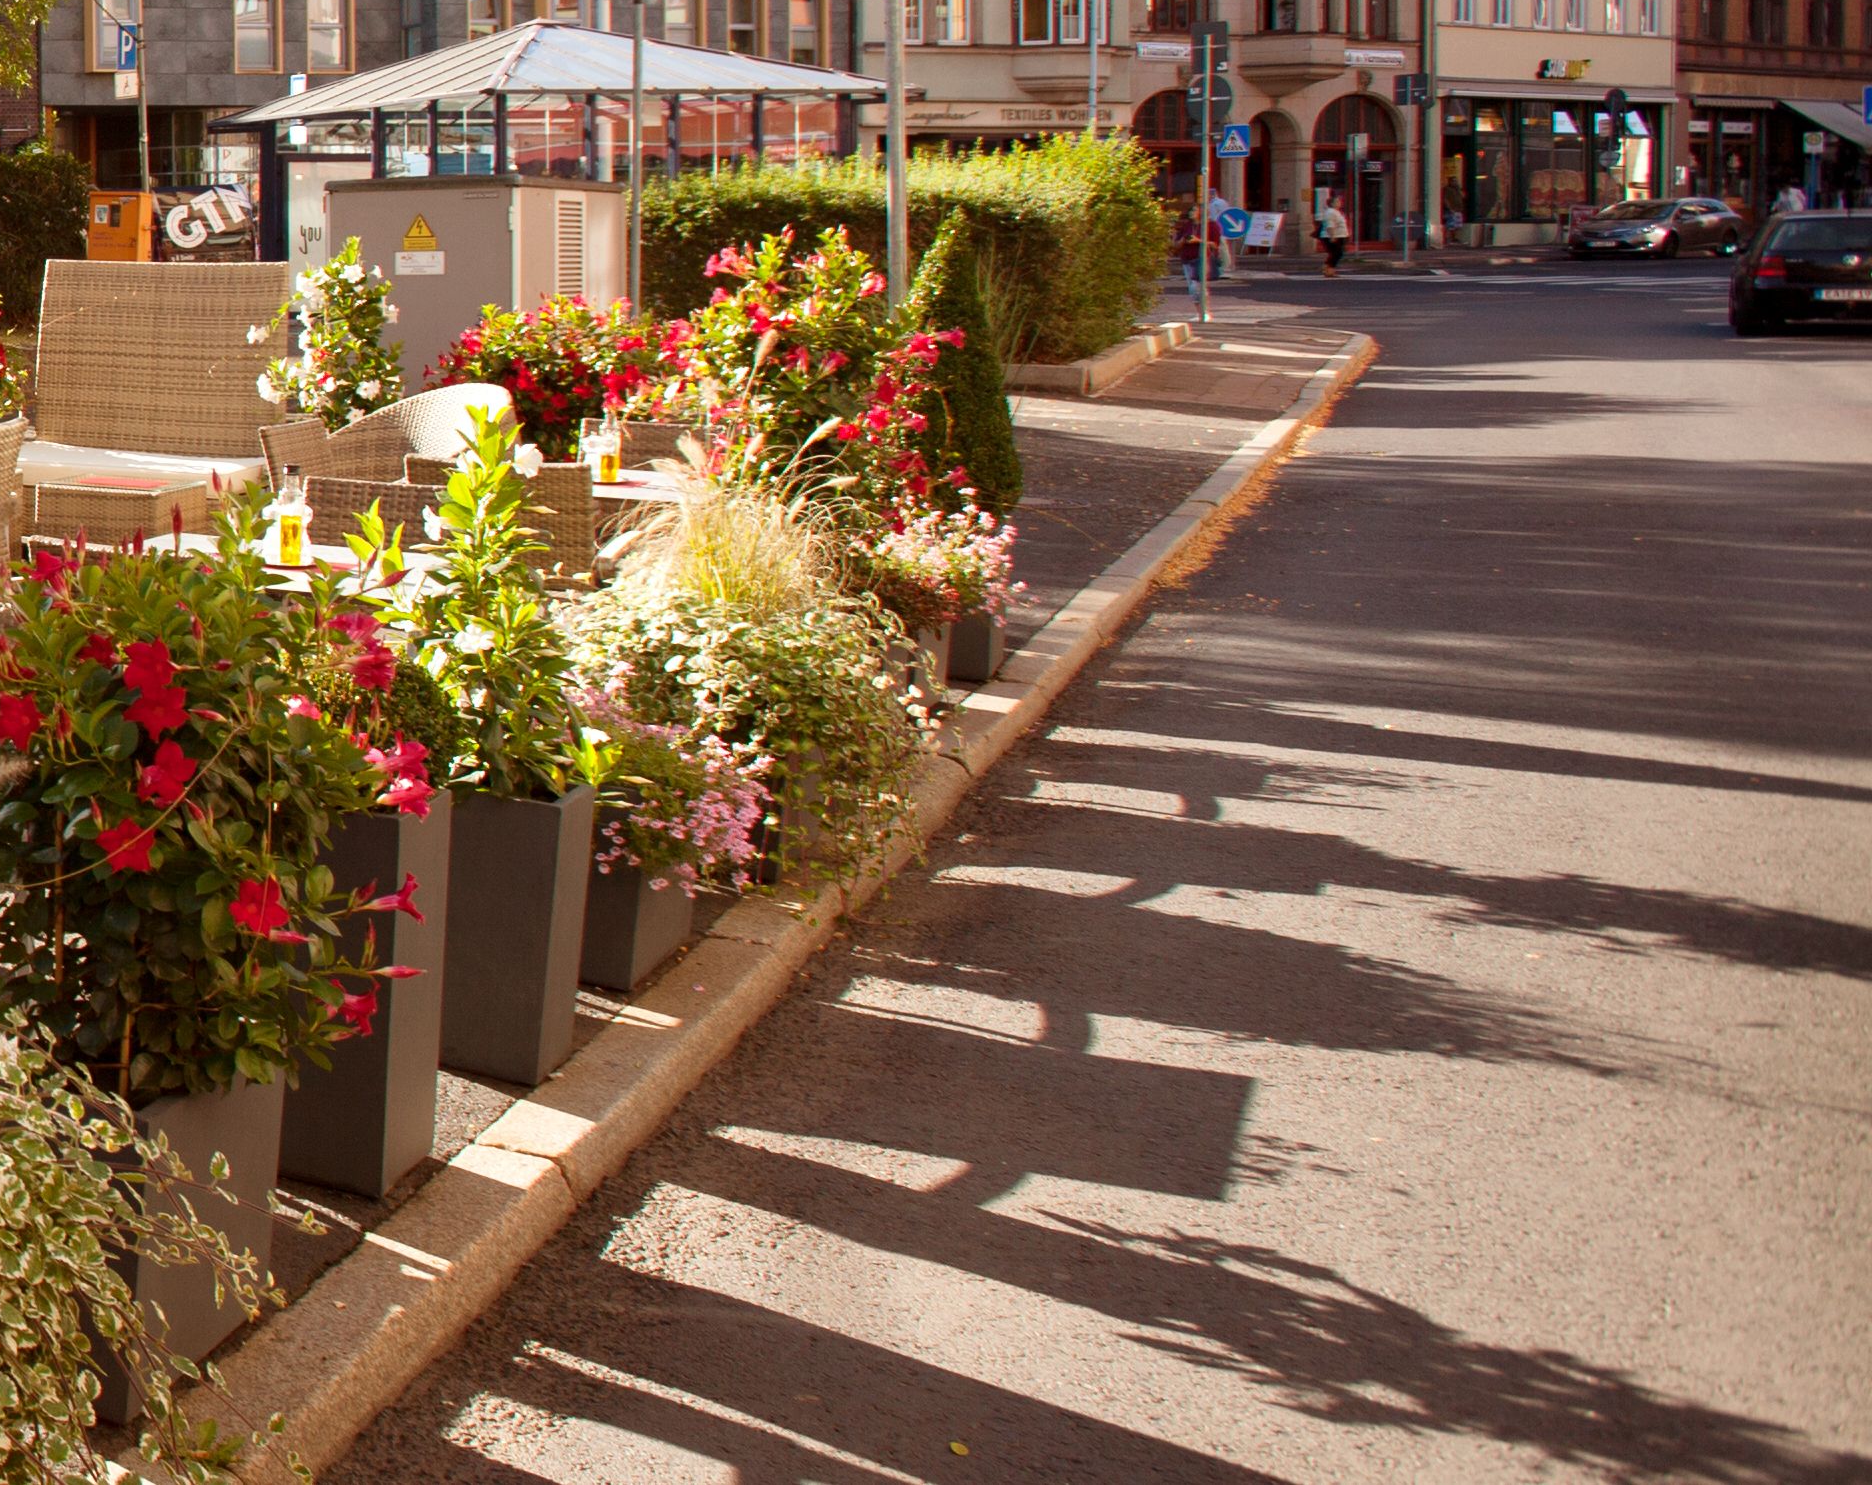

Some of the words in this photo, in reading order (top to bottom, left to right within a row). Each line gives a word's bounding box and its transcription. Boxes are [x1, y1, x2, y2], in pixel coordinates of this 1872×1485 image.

[121, 29, 133, 65] P
[1000, 108, 1052, 121] TEXTILES
[1056, 109, 1112, 121] WOHEN
